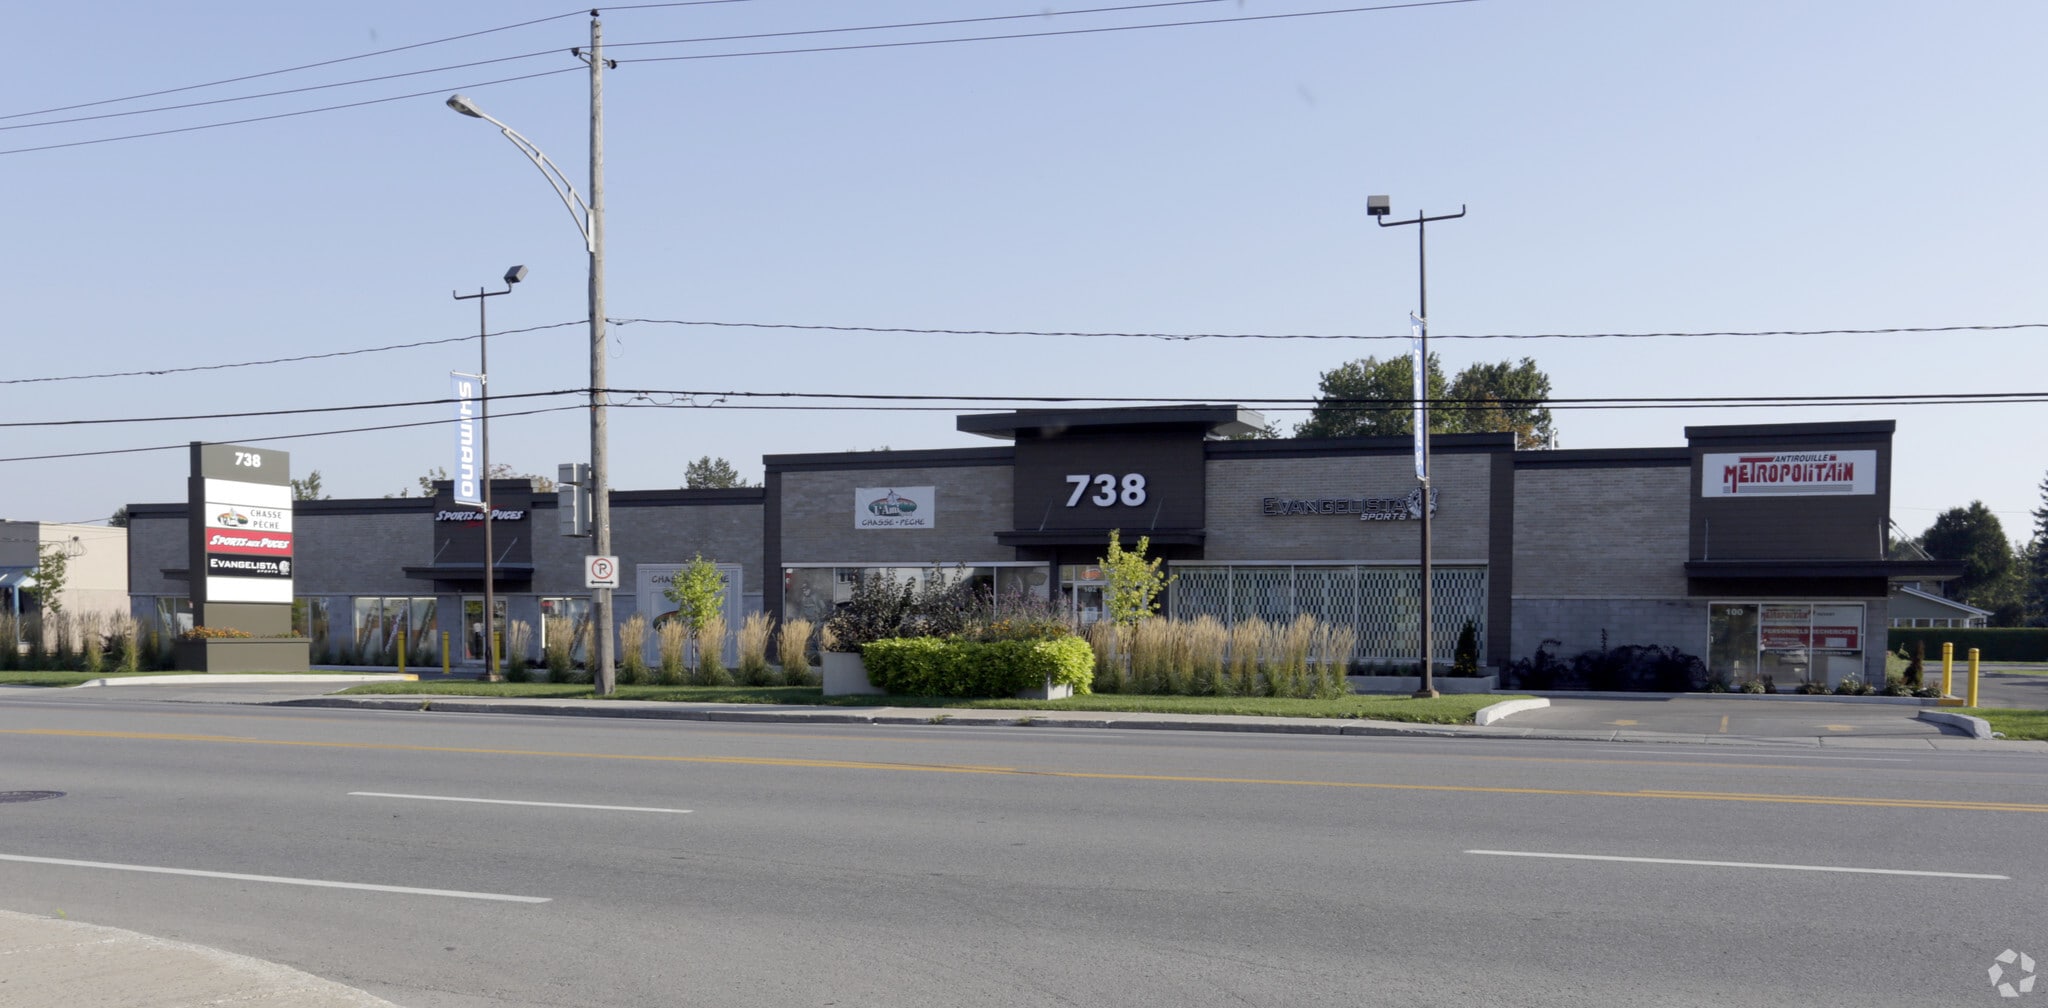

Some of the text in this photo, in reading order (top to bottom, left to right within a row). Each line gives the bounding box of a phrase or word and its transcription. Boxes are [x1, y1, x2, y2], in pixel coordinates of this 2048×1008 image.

[459, 381, 474, 498] SHIMANO
[235, 452, 261, 467] 738
[1774, 454, 1828, 463] ANTIROUILLE
[1065, 473, 1147, 507] 738
[1263, 497, 1408, 516] EVANGELISTA
[250, 509, 282, 519] CHASSE
[436, 510, 475, 520] SPORTS
[491, 510, 523, 520] PUCES
[1360, 513, 1407, 521] SPORTS
[210, 535, 247, 547] SPORTS
[260, 538, 289, 549] PUCES
[210, 558, 278, 570] EVANGELISTA
[1726, 608, 1744, 616] 100
